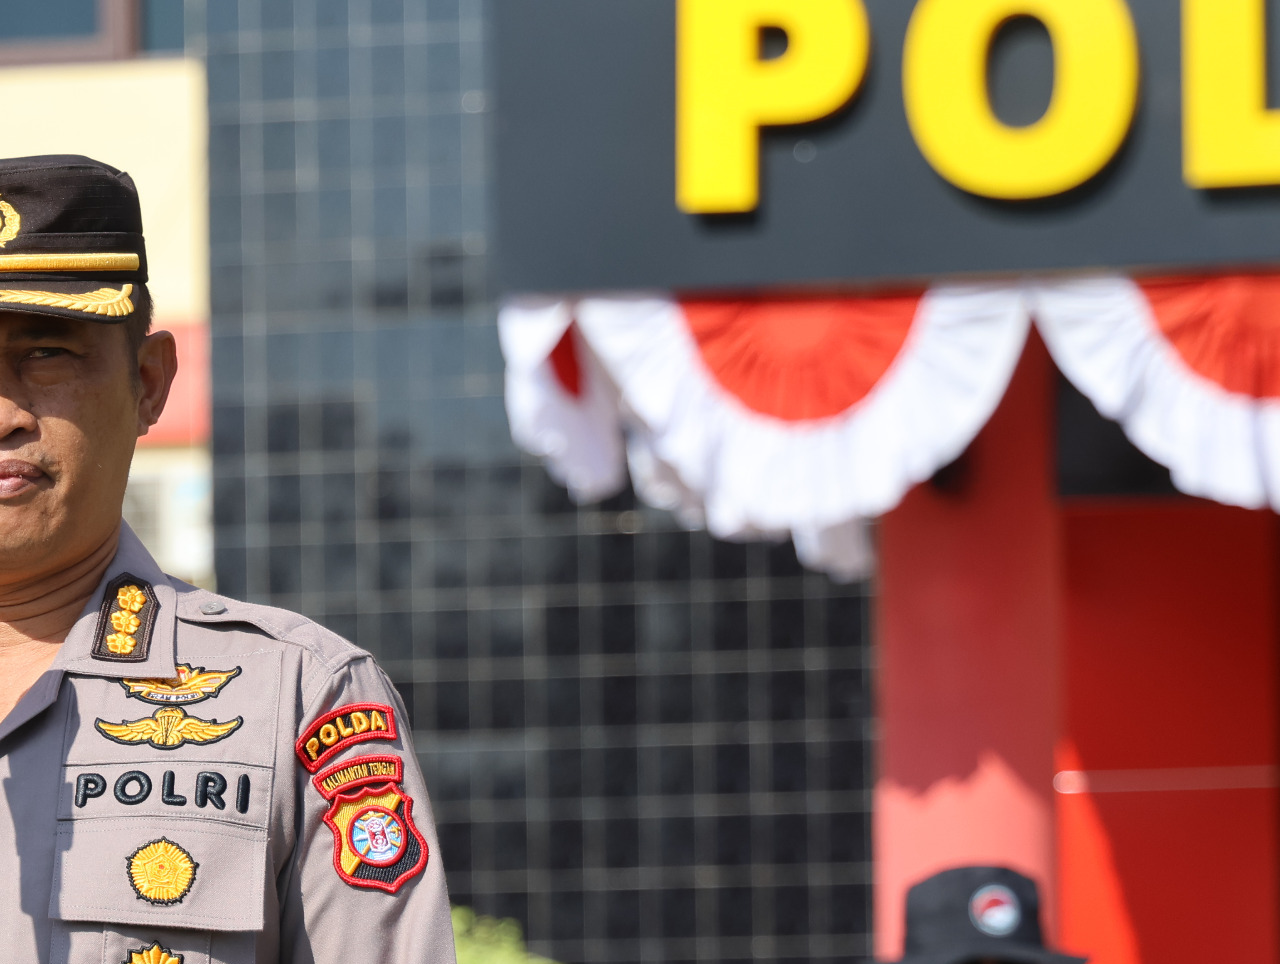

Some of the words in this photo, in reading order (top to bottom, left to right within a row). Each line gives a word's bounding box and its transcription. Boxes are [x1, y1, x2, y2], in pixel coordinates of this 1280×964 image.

[305, 710, 388, 761] POLDA
[74, 769, 252, 814] POLRI
[321, 763, 369, 792] KALIMANTAN
